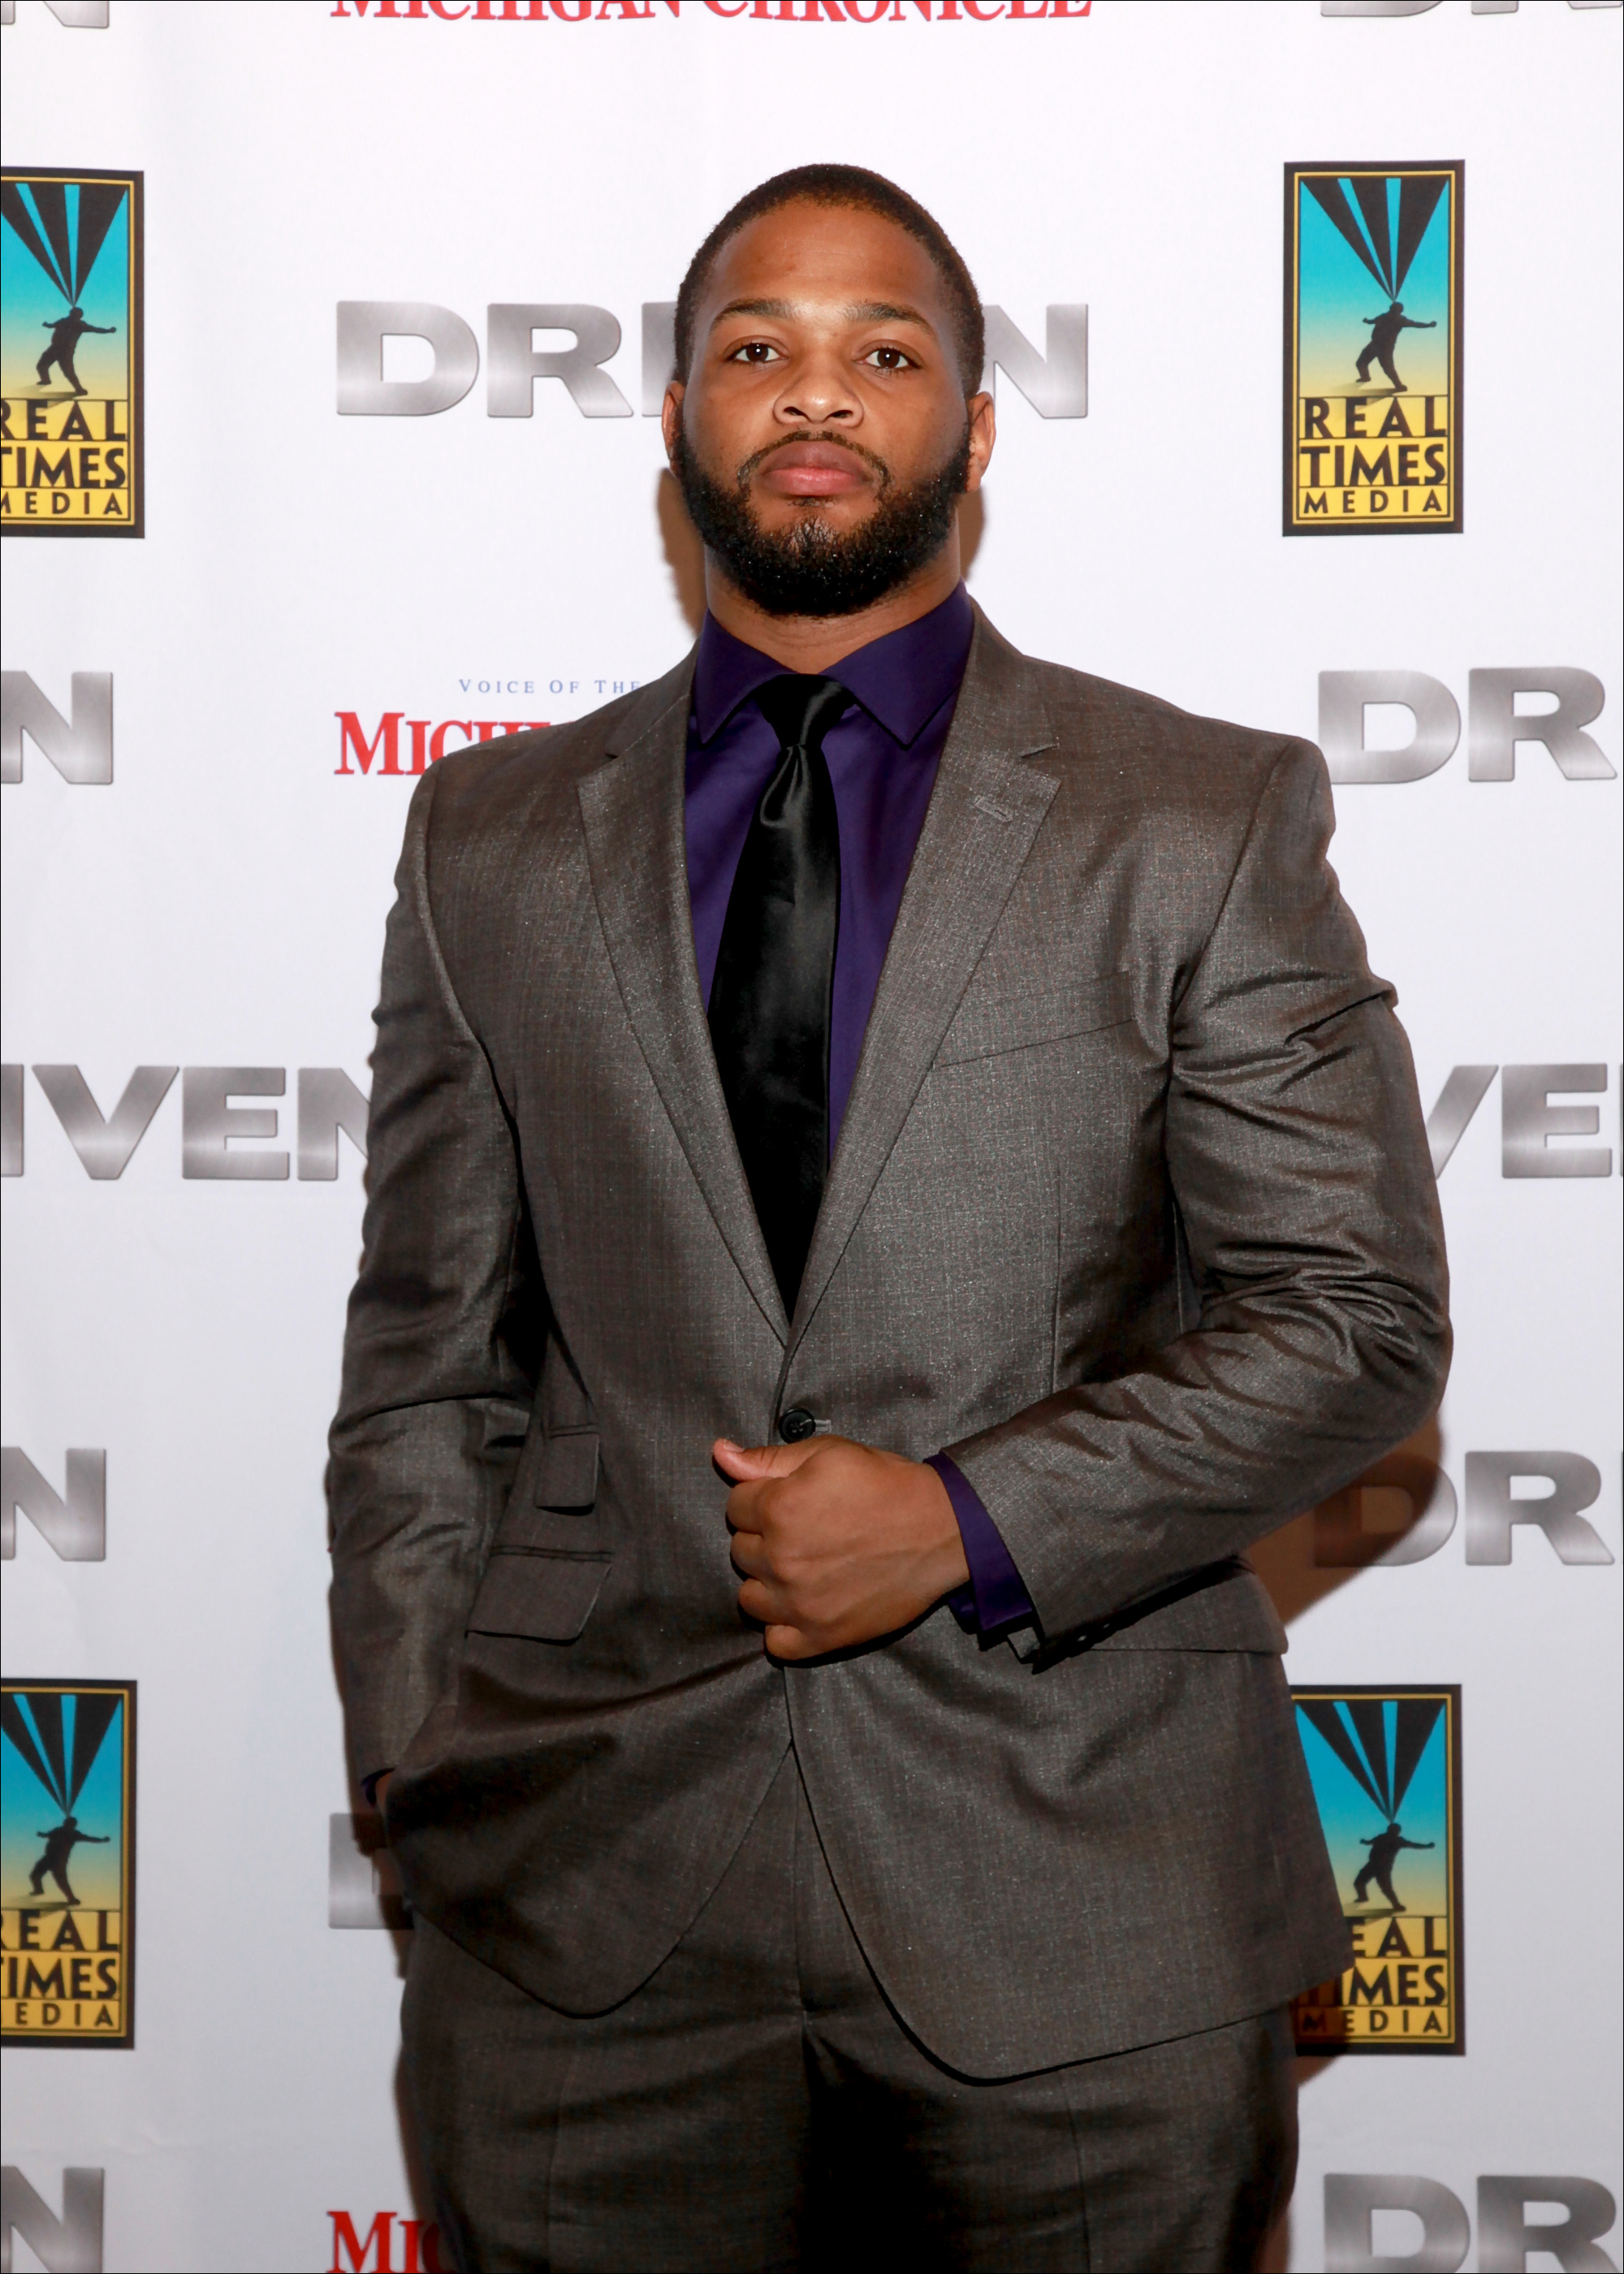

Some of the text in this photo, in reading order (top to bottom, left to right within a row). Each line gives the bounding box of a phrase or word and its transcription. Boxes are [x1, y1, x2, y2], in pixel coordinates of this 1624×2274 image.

[1305, 397, 1446, 438] REAL
[1301, 443, 1445, 486] TIMES
[1303, 489, 1442, 514] MEDIA
[459, 679, 640, 694] VOICE OF THE
[1318, 666, 1618, 785] DR
[1314, 1450, 1623, 1567] DR
[1, 1910, 119, 1951] EAL
[1345, 1917, 1446, 1956] EAL
[1, 1956, 116, 1999] IMES
[1, 2002, 113, 2026] EDIA
[1303, 2009, 1442, 2033] MEDIA
